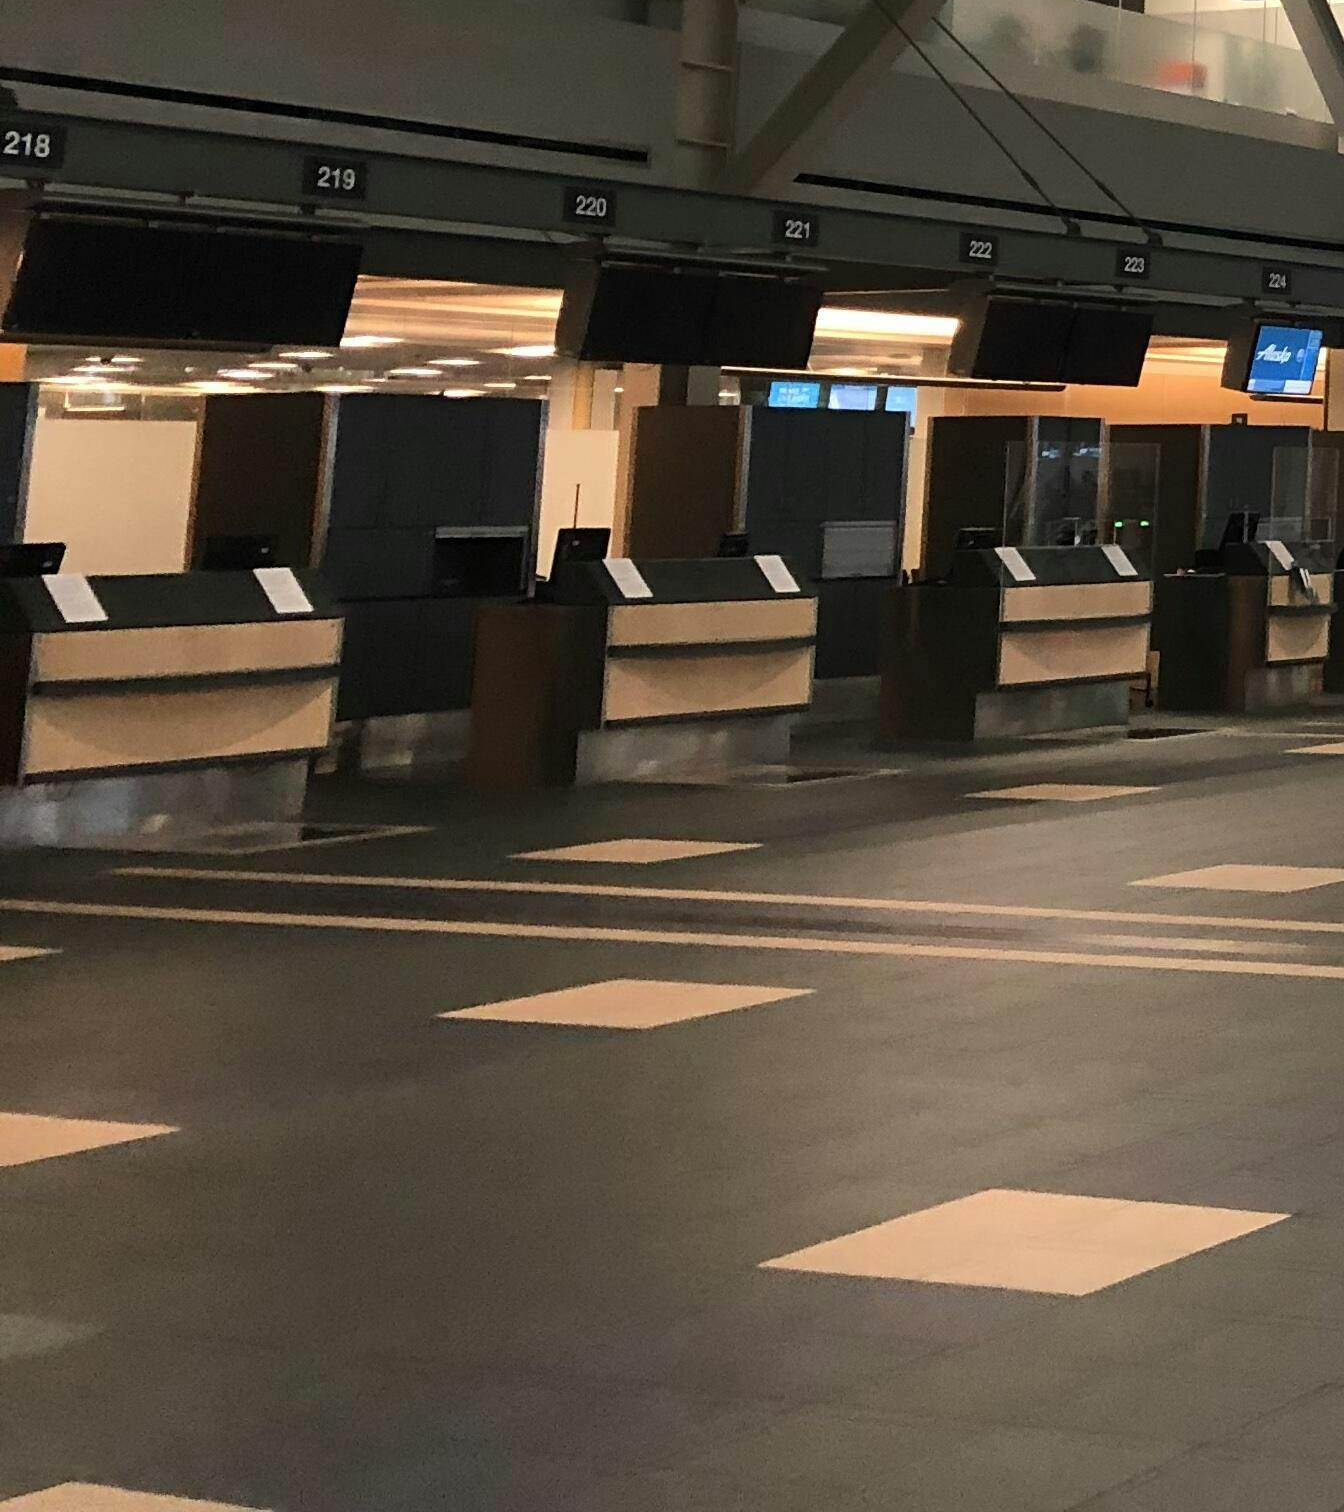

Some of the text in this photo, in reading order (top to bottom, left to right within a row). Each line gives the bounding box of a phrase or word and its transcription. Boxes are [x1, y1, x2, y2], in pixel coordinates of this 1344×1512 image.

[3, 131, 51, 158] 218
[317, 166, 356, 190] 219
[575, 195, 607, 217] 220
[784, 219, 811, 239] 221
[969, 240, 993, 259] 222
[1124, 256, 1145, 273] 223
[1268, 272, 1287, 289] 224
